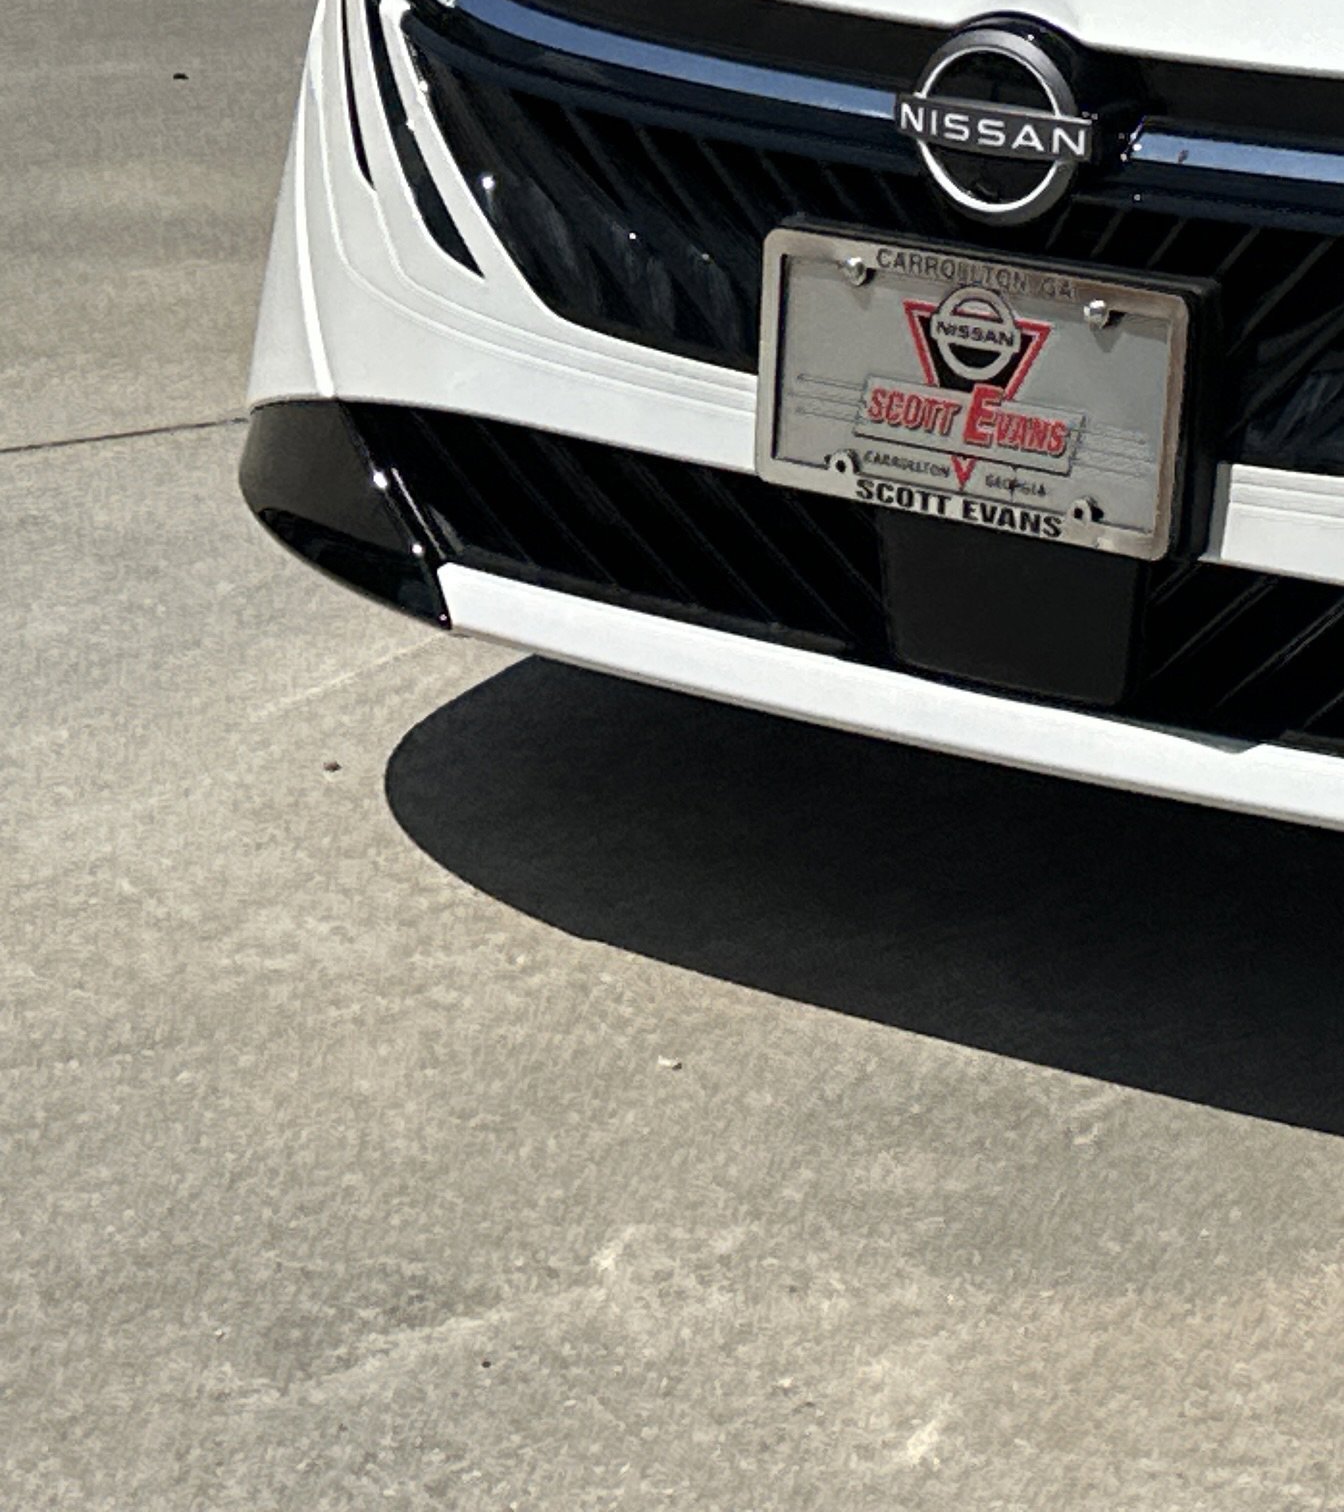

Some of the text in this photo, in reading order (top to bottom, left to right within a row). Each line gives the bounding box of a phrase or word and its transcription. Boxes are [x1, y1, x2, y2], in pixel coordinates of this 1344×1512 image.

[900, 102, 1086, 156] NISSAN
[936, 320, 1014, 346] NISSAN
[867, 383, 1070, 456] SCOTT EVANS
[856, 479, 1063, 538] SCOTT EVANS
